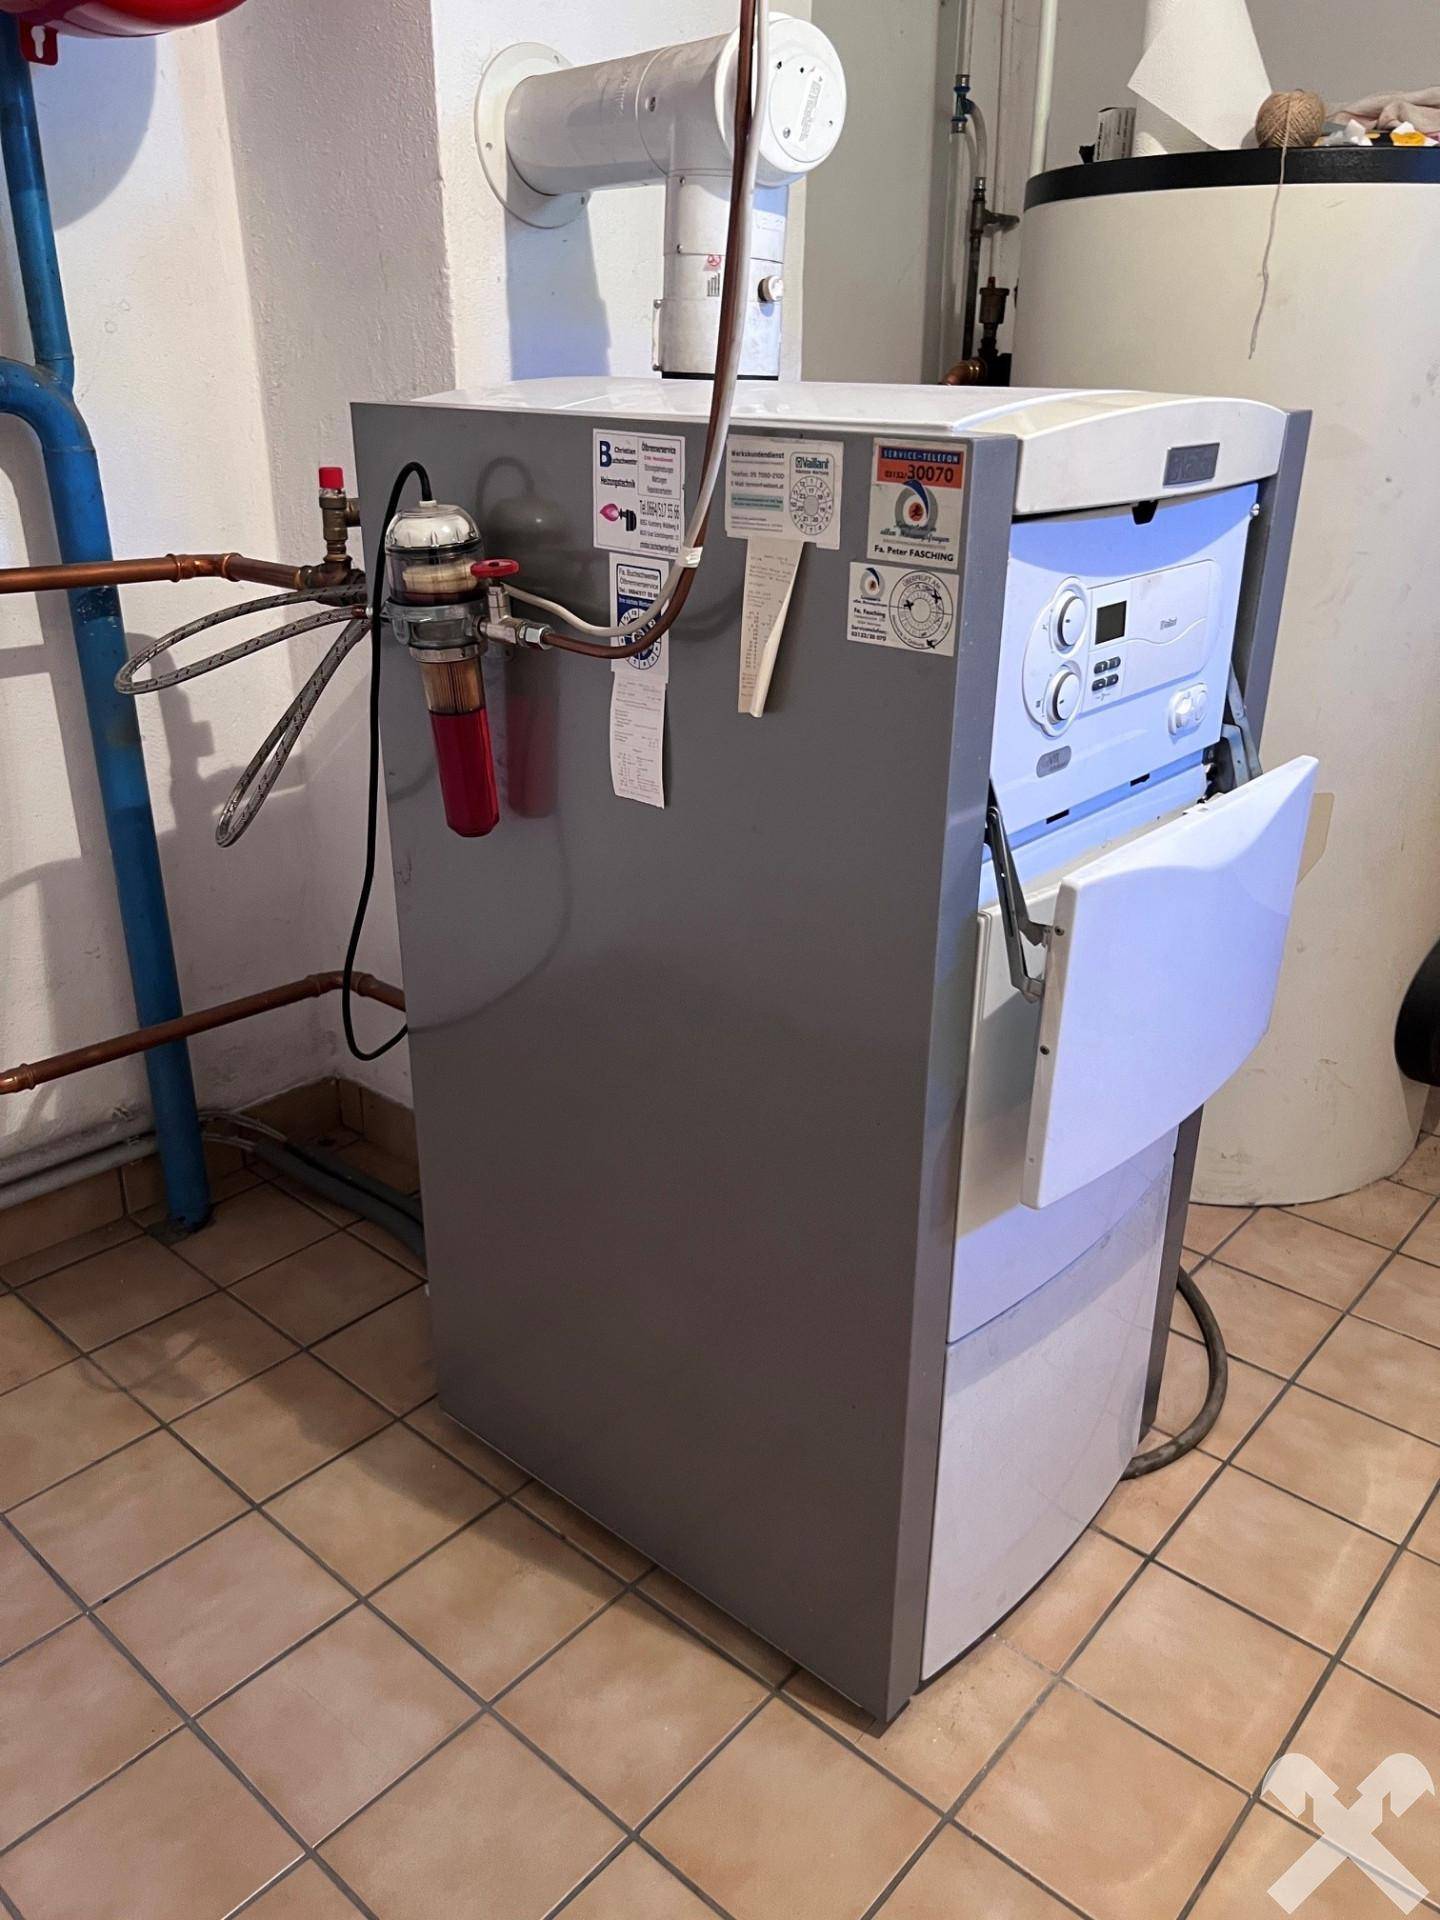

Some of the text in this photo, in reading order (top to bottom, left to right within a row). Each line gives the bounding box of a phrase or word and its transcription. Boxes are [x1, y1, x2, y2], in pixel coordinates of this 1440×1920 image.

[731, 450, 784, 458] Werkskundendienst
[884, 450, 958, 462] SERVICE-TELEFON
[802, 457, 829, 469] Vaillant
[874, 545, 954, 561] Fa. Peter FASCHING
[863, 608, 886, 618] Fasching
